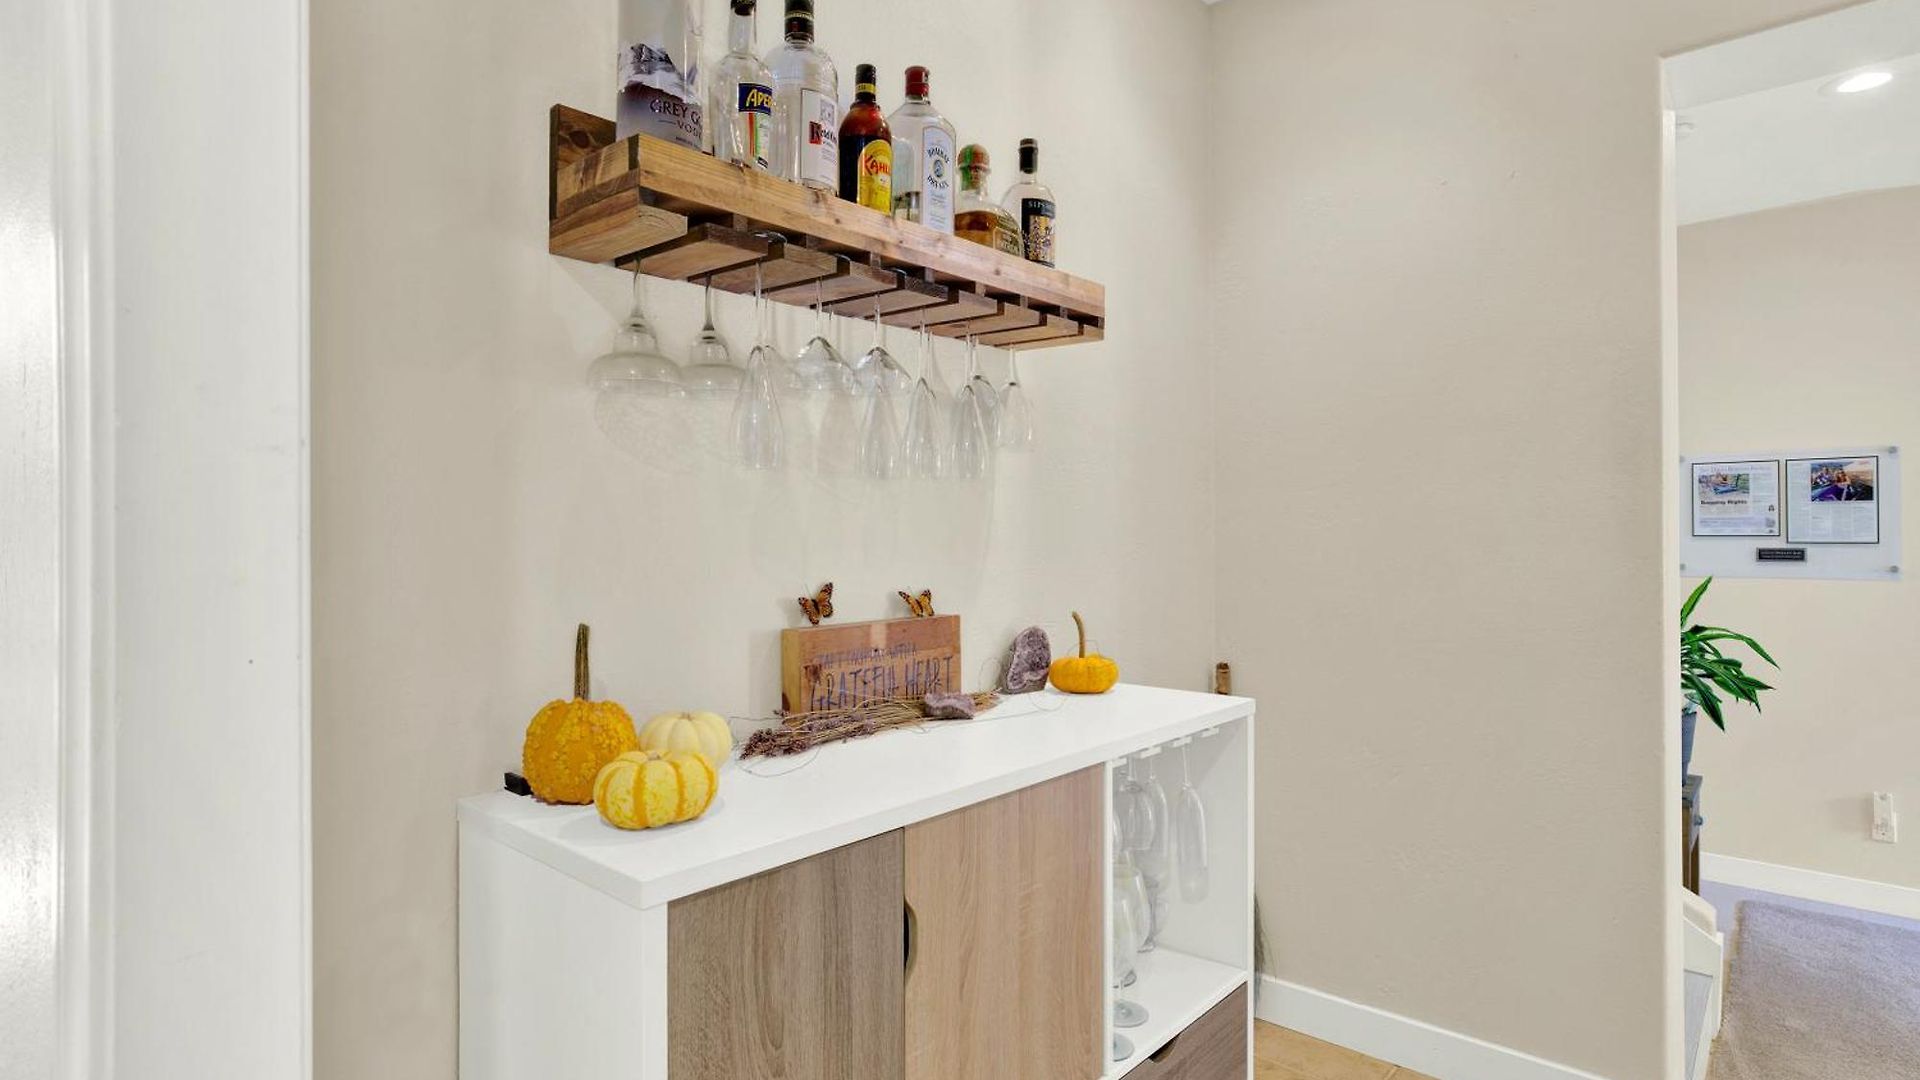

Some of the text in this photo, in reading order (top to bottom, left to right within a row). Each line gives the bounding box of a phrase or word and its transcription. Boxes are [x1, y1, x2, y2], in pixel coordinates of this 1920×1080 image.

[650, 98, 688, 118] GREY
[862, 154, 892, 177] KAHL
[810, 664, 899, 712] GRATEFUL
[904, 656, 953, 701] HEART
